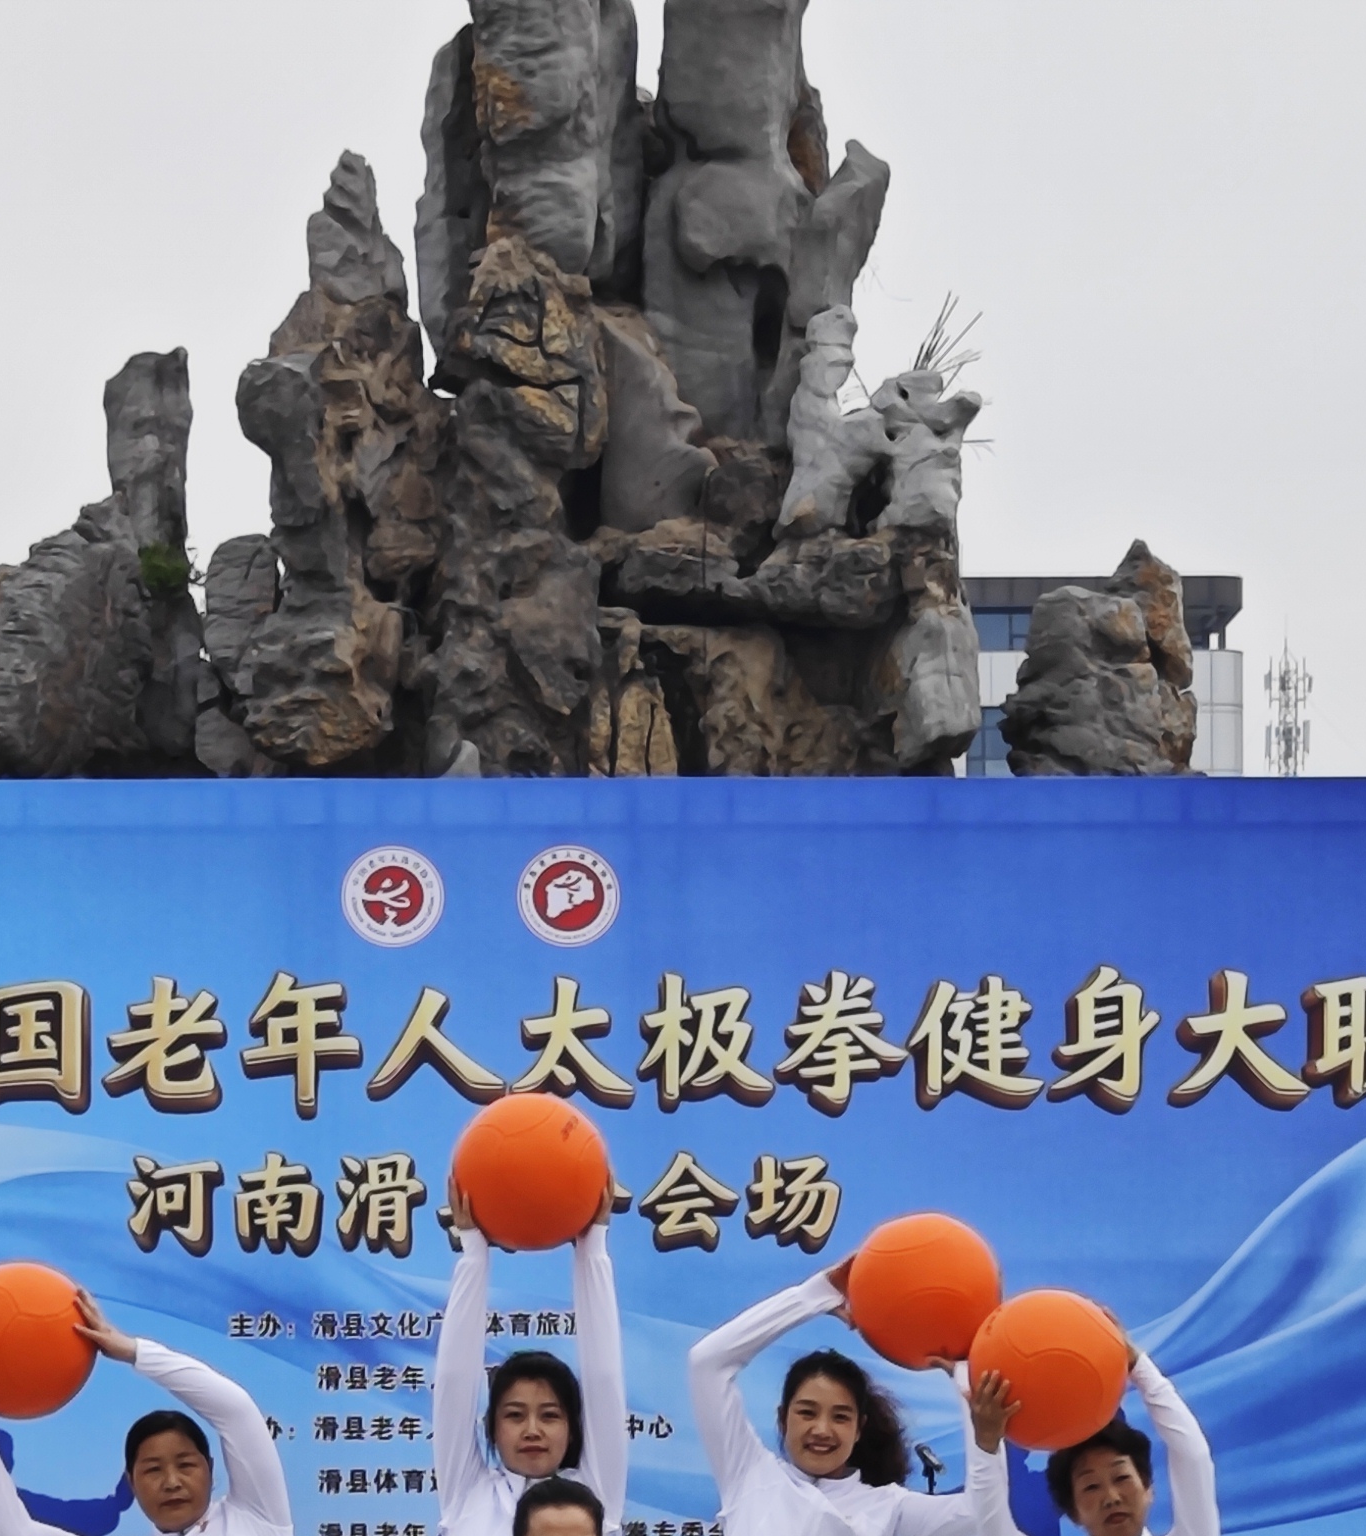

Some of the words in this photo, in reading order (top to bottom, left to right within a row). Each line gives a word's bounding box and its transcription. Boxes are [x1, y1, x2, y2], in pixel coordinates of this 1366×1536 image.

[126, 1150, 841, 1258] 河南滑会场
[317, 1365, 436, 1391] 滑县老年
